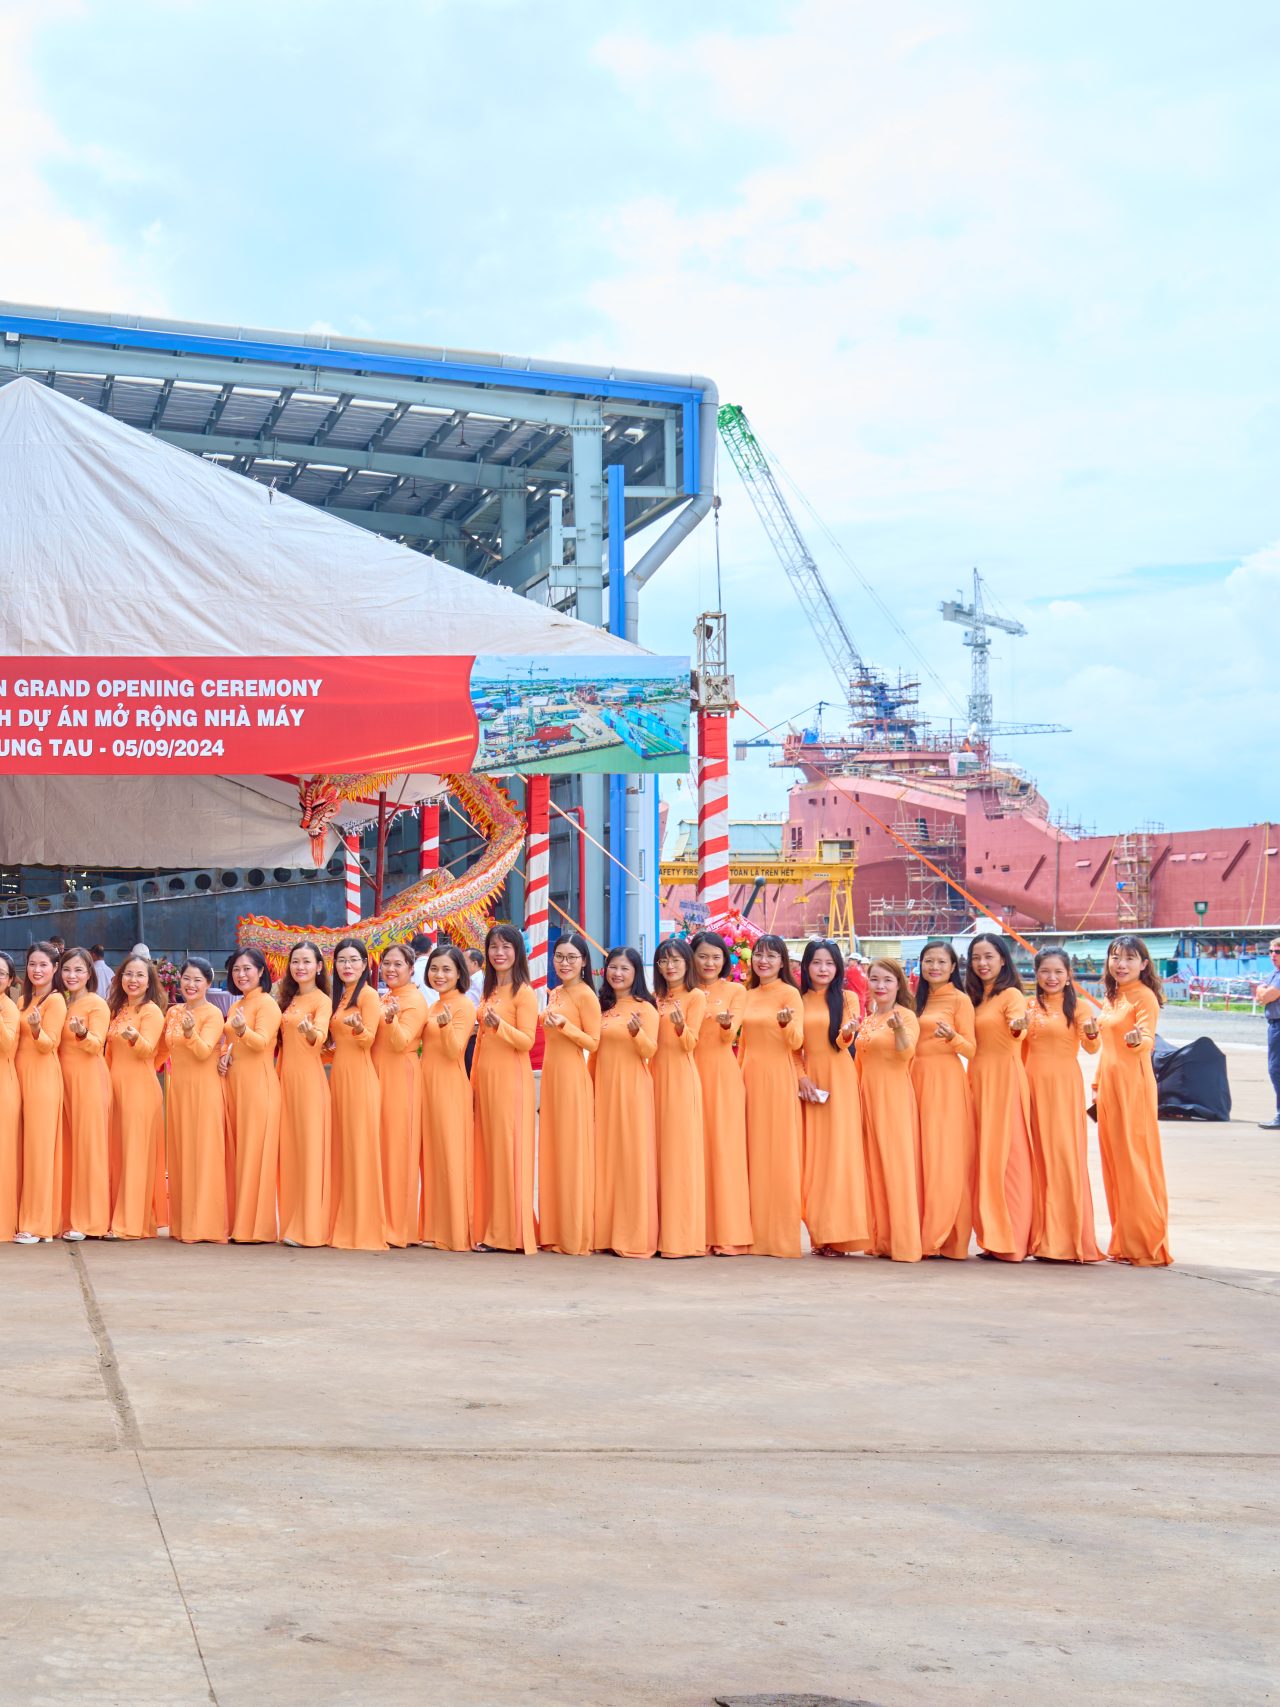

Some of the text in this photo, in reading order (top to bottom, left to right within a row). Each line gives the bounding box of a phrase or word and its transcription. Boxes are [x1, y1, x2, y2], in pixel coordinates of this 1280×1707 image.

[13, 679, 91, 698] GRAND
[96, 679, 195, 698] OPENING
[201, 679, 323, 698] CEREMONY
[18, 709, 52, 731] DỰ
[57, 705, 88, 727] ÁN
[95, 702, 130, 727] MỞ
[136, 705, 198, 731] RỘNG
[204, 705, 252, 727] NHÀ
[257, 704, 305, 727] MÁY
[49, 739, 93, 757] TAU
[112, 739, 225, 758] 05/09/2024
[658, 868, 699, 876] AFETY FIRS
